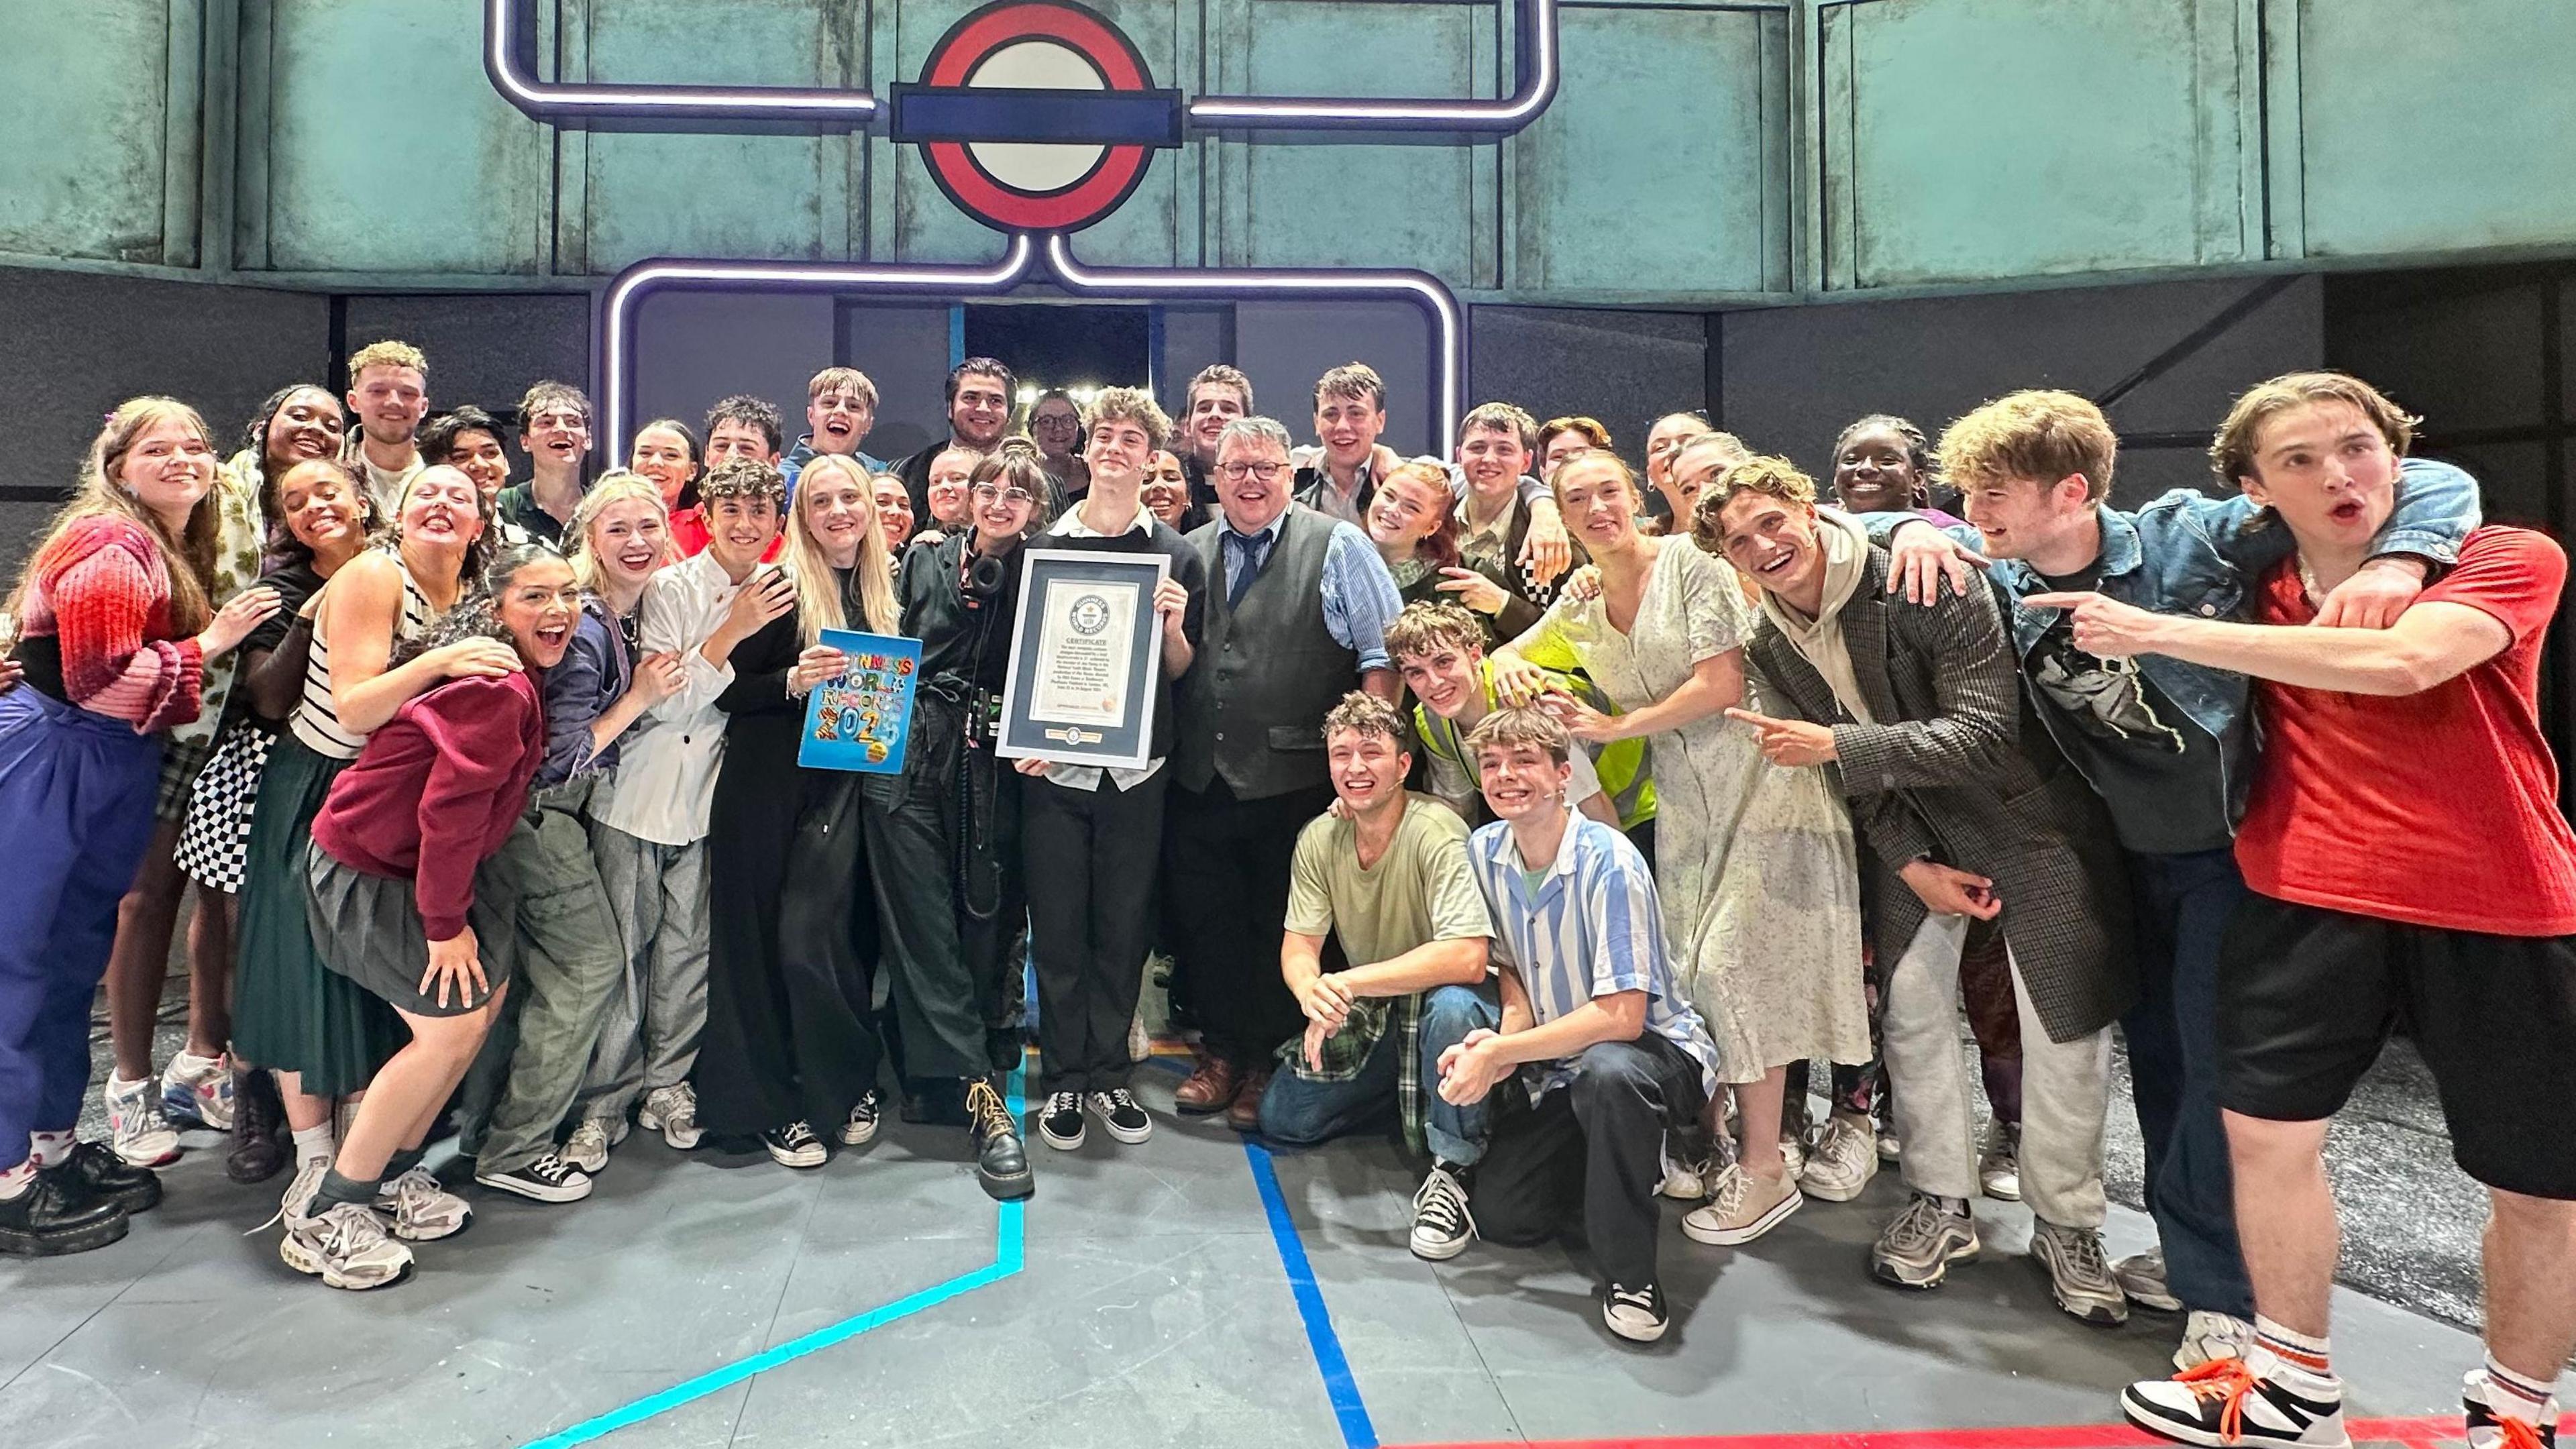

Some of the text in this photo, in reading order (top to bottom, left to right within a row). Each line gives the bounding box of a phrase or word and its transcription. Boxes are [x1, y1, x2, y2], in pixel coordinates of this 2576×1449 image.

[1076, 596, 1106, 609] GUINNESS
[1071, 612, 1084, 633] WORLD
[1066, 637, 1107, 646] CERTIFICATE
[821, 688, 906, 713] RECORDS
[814, 707, 900, 746] 2025
